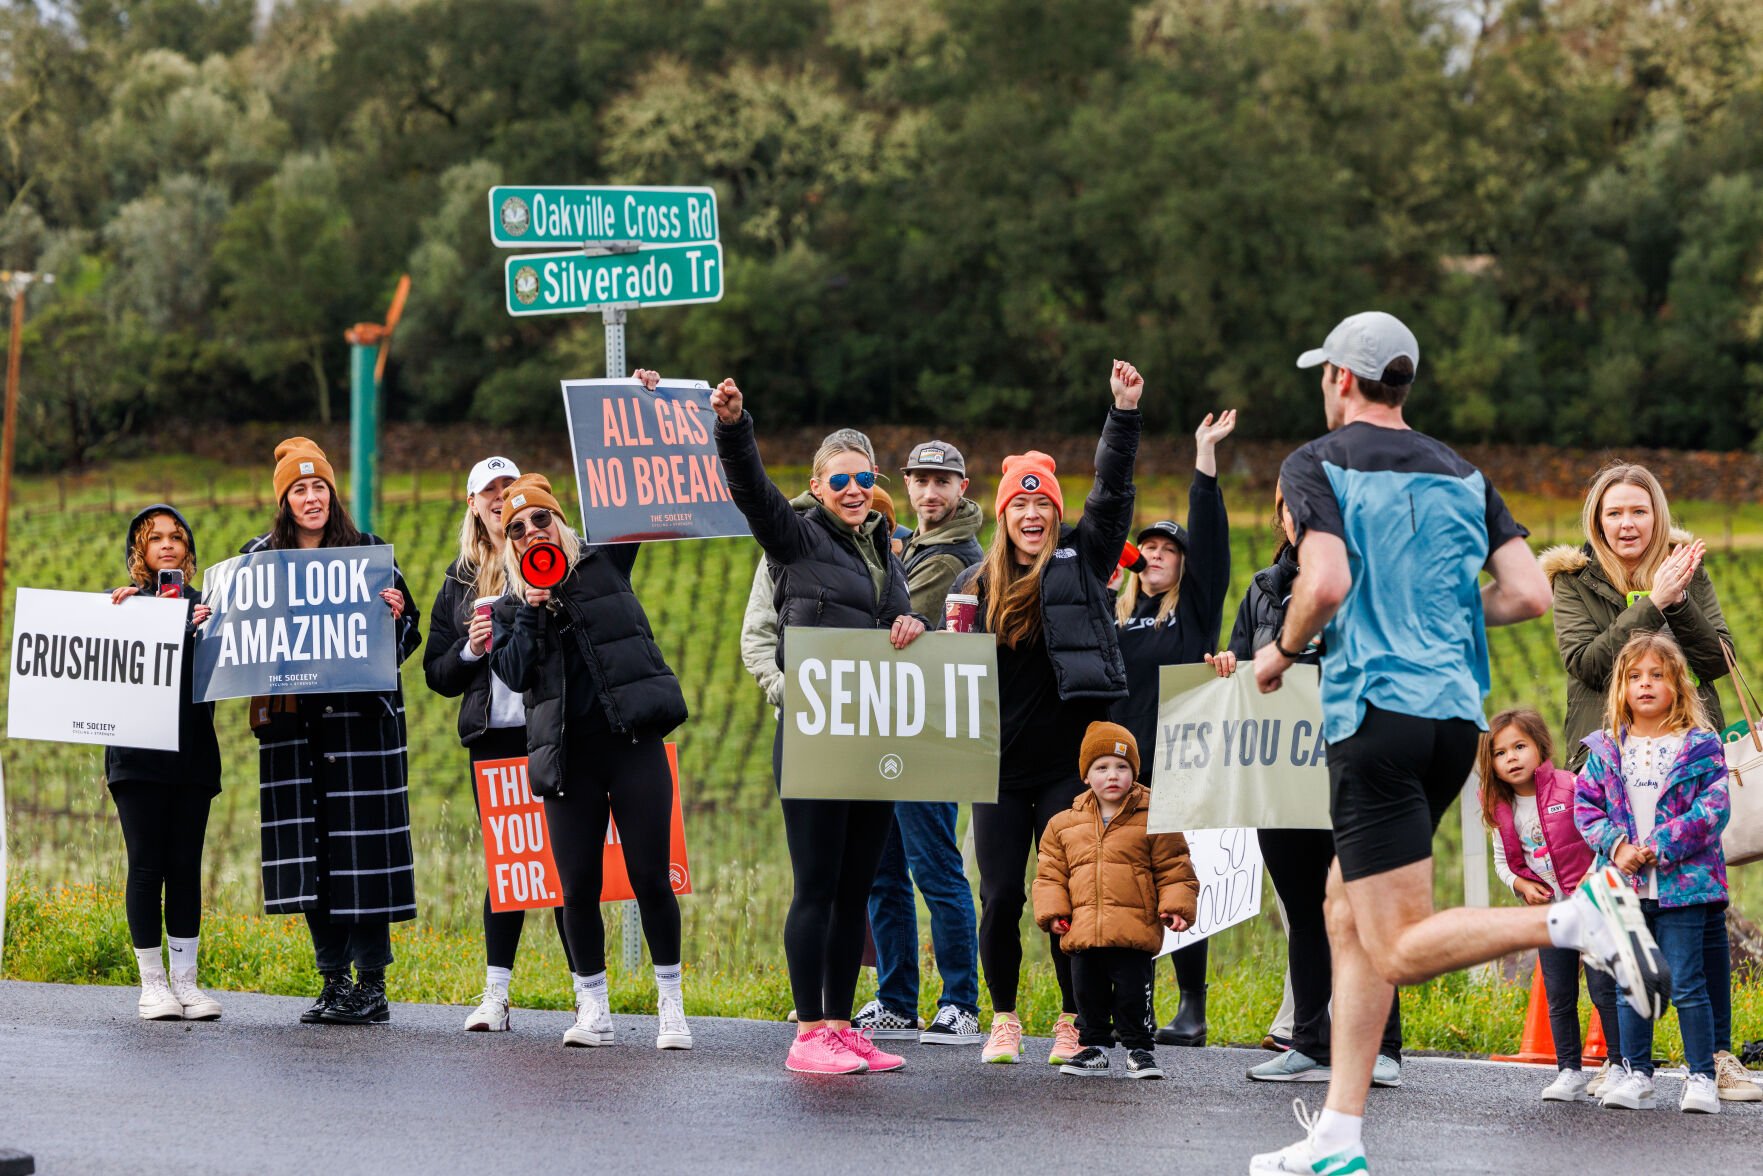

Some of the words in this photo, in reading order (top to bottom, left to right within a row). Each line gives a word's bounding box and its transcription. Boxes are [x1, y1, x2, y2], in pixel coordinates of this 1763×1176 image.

[532, 193, 615, 237] Oakville
[624, 195, 681, 238] Cross
[687, 197, 713, 239] Rd
[543, 255, 673, 304] Silverado
[686, 250, 715, 293] Tr
[602, 398, 653, 447] ALL
[654, 398, 709, 446] GAS
[586, 457, 627, 508] NO
[632, 455, 733, 505] BREAK
[651, 515, 663, 523] THE
[664, 513, 692, 522] SOCIETY
[216, 563, 275, 614] YOU
[288, 558, 371, 607] LOOK
[16, 632, 146, 685] CRUSHING
[153, 642, 179, 687] IT
[218, 612, 368, 668] AMAZING
[285, 673, 318, 682] SOCIETY
[796, 657, 926, 737] SEND
[944, 663, 988, 739] IT
[72, 721, 85, 729] THE
[86, 722, 116, 731] SOCIETY
[1163, 721, 1213, 771] YES
[1222, 718, 1281, 767] YOU
[1290, 719, 1329, 768] CA
[481, 764, 544, 808] THI
[1633, 777, 1659, 789] Lucky
[488, 811, 544, 856] YOU
[1214, 828, 1247, 876] SO
[495, 861, 556, 904] FOR.
[1177, 863, 1256, 945] OUD!
